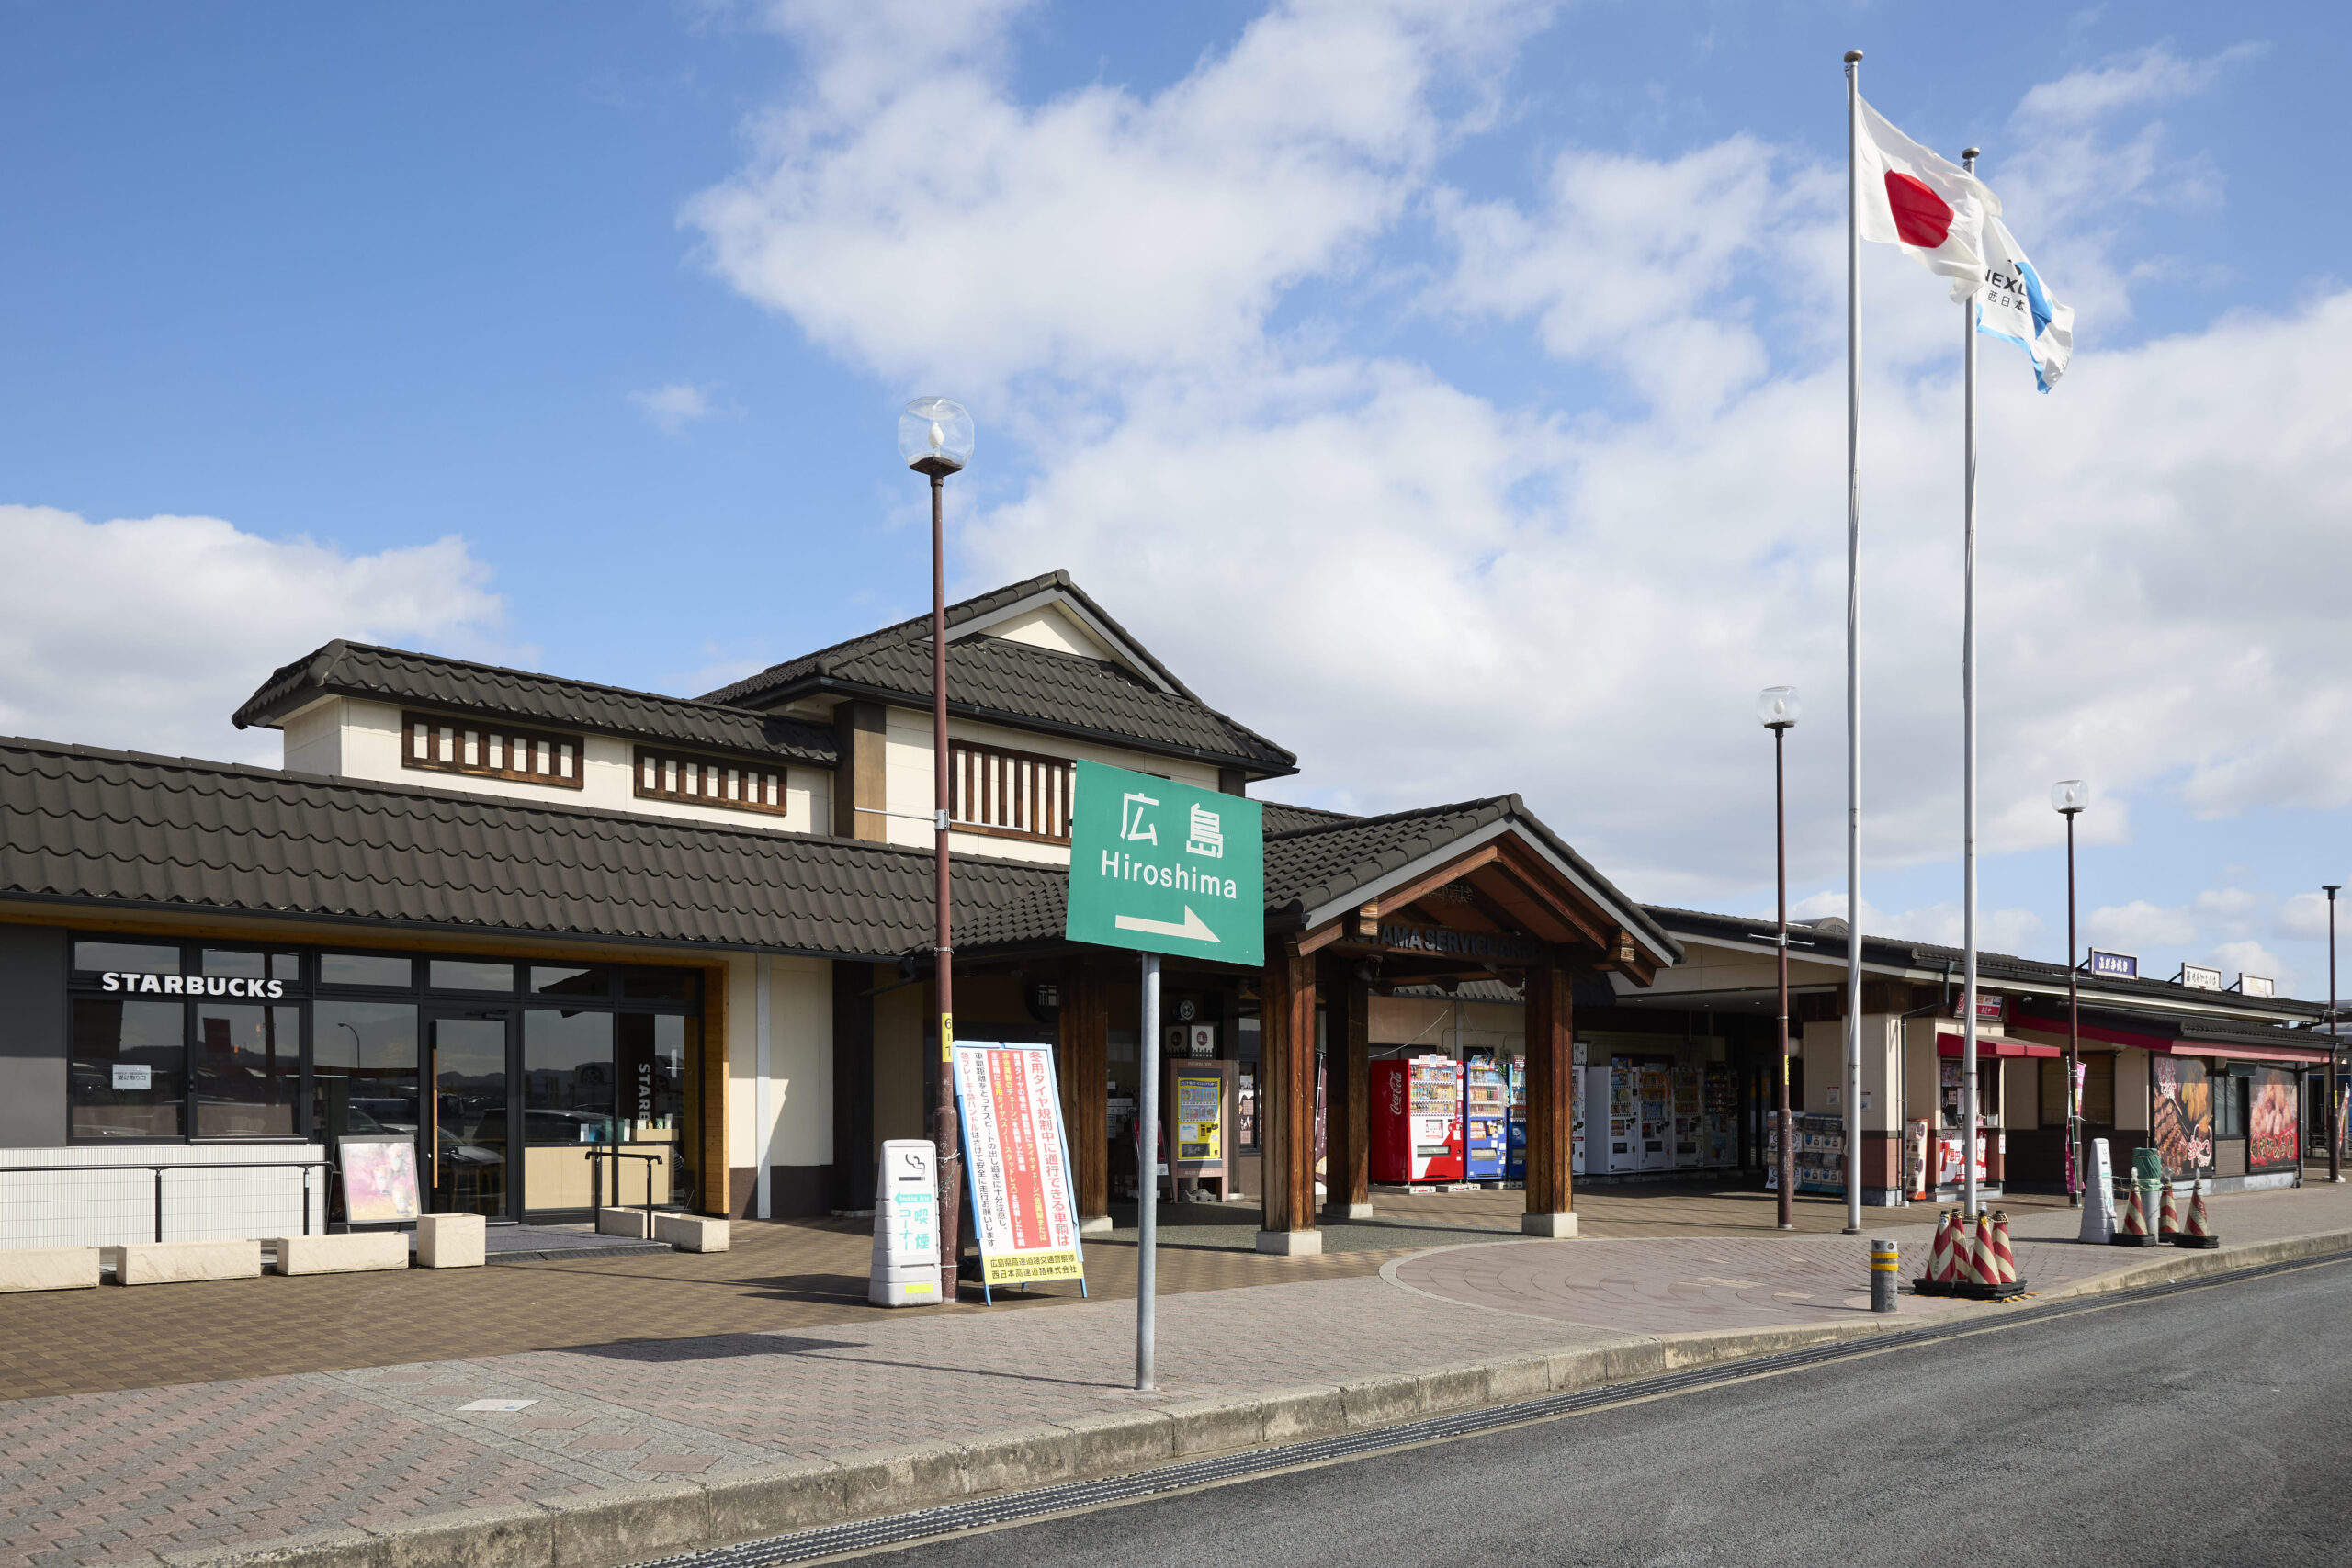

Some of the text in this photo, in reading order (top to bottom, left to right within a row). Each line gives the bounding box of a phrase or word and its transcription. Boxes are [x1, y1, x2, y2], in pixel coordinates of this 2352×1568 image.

[1987, 289, 2027, 311] 西日本
[1120, 792, 1224, 859] 広島
[1101, 849, 1238, 899] Hiroshima
[102, 972, 284, 998] STARBUCKS
[899, 1209, 913, 1251] コーナー
[914, 1208, 931, 1250] 喫煙
[990, 1254, 1076, 1268] 広島県高速道路交通警察隊
[991, 1265, 1078, 1280] 西日本高速道路株式会社
